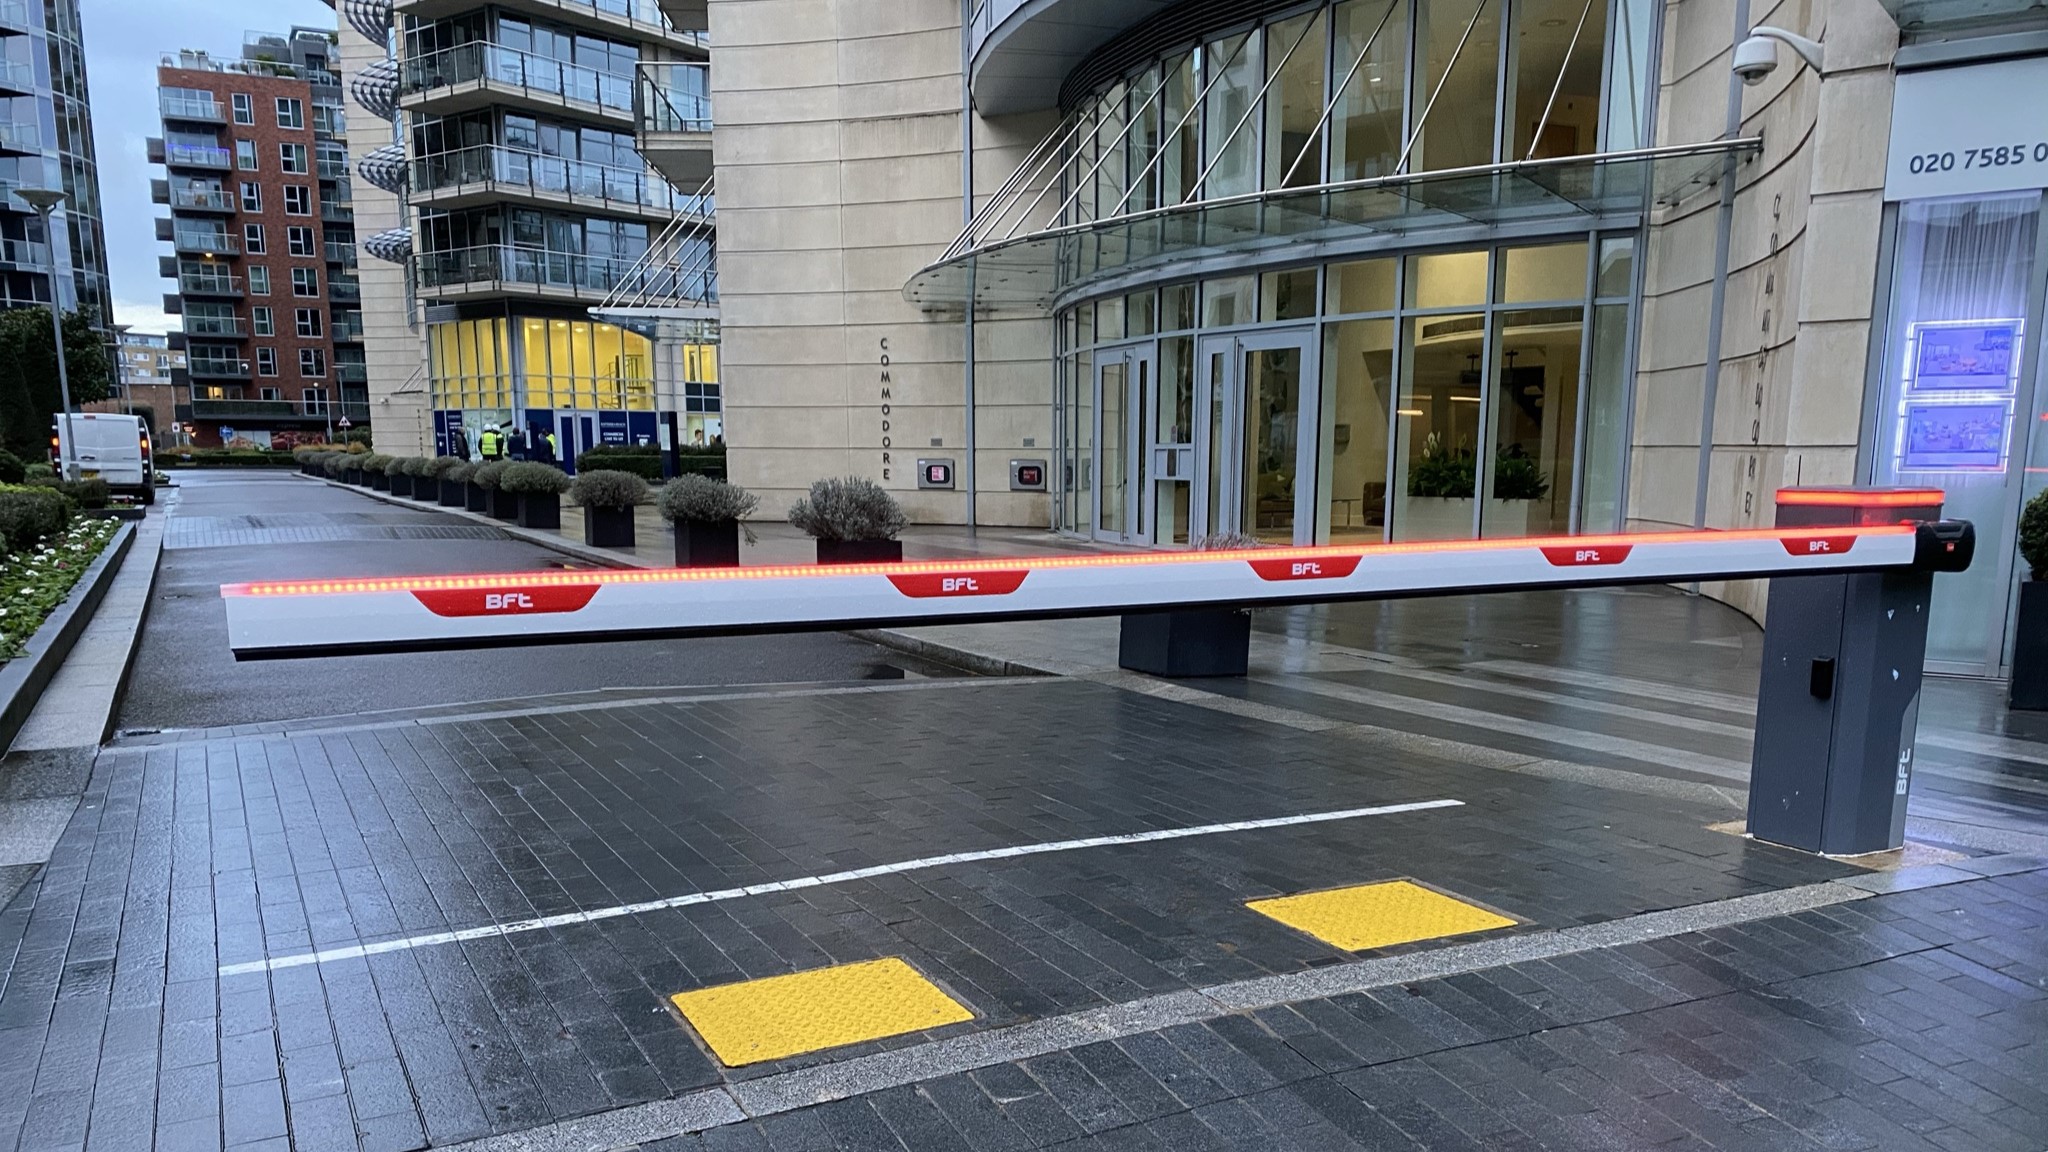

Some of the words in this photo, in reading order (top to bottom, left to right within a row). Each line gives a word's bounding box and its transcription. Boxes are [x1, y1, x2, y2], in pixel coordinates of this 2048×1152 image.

[1909, 152, 1955, 174] 020
[1964, 144, 2026, 170] 7585
[880, 337, 891, 480] COMMODORE
[942, 577, 978, 592] BFt
[485, 593, 534, 609] BFt
